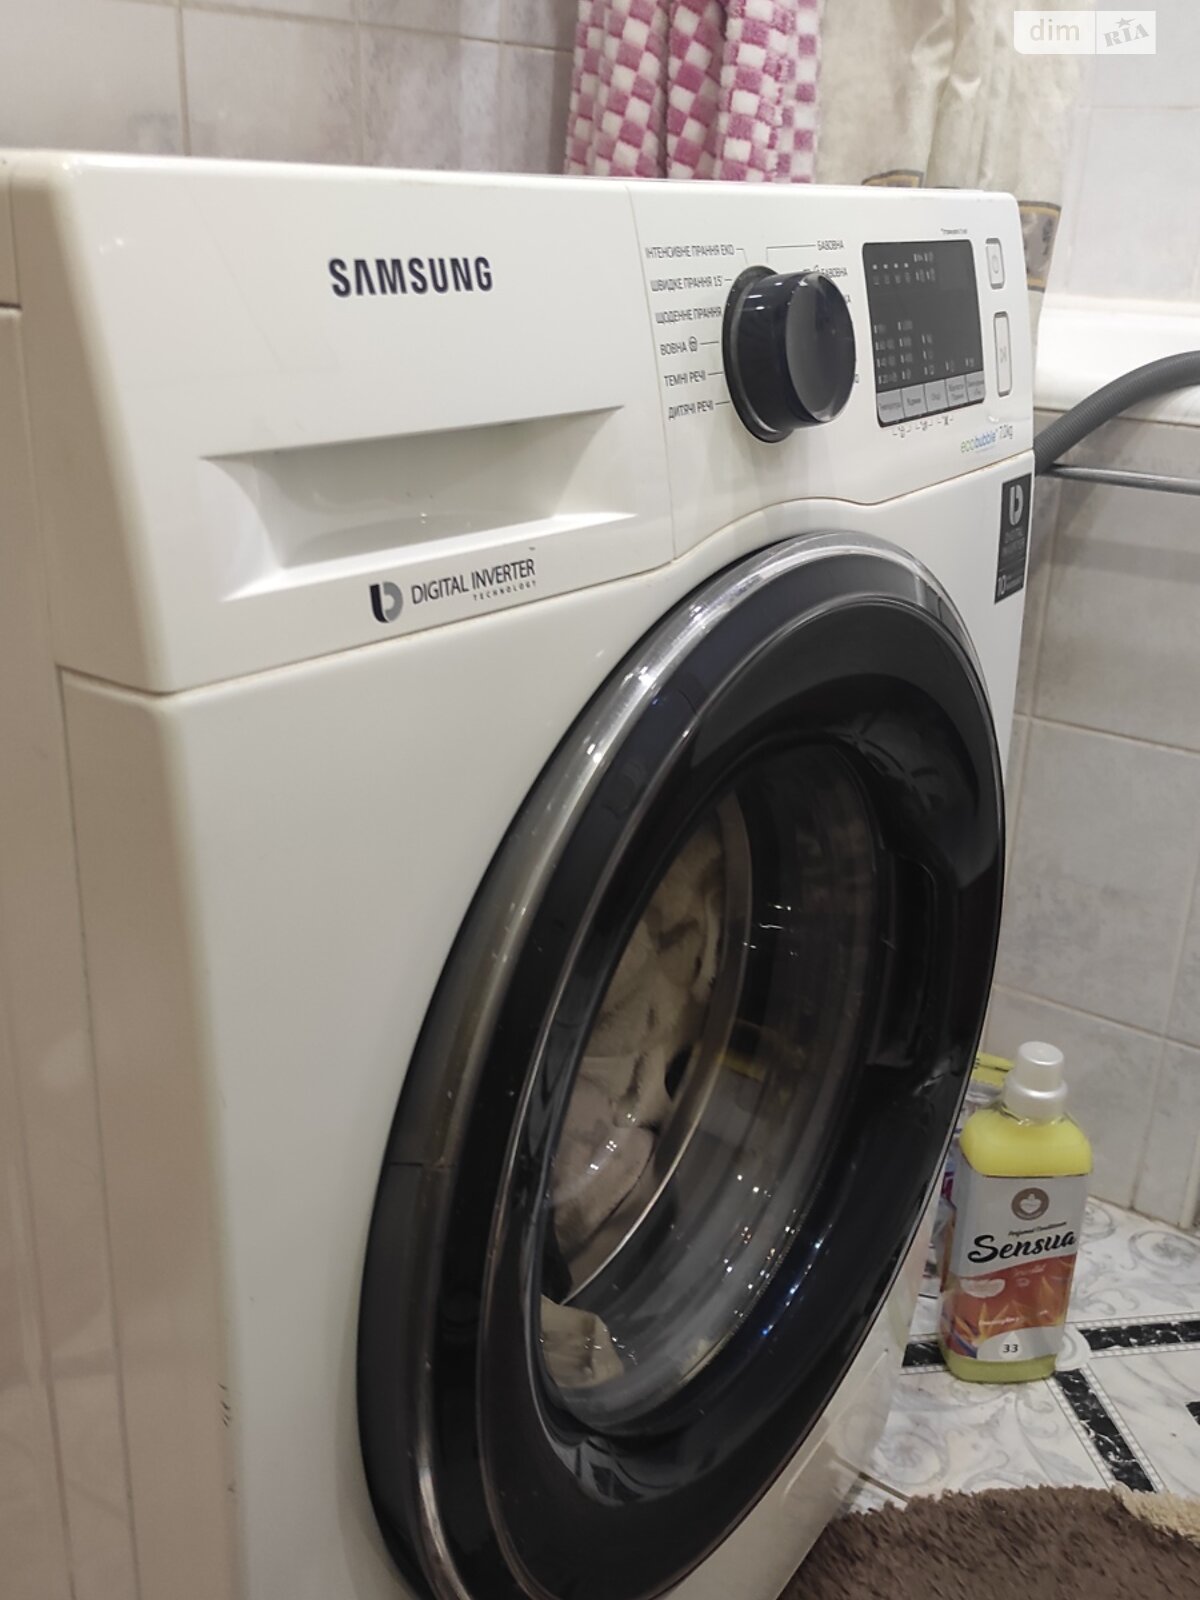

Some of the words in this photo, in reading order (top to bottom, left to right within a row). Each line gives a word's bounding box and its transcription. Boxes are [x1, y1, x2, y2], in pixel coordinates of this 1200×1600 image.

[692, 245, 719, 257] ПРАННЯ
[817, 240, 844, 250] БАВОВНА
[328, 256, 493, 298] SAMSUNG
[650, 278, 683, 292] ШВИДКЕ
[684, 276, 712, 288] ПРАННЯ
[655, 309, 693, 324] ЩОДЕННЕ
[660, 342, 687, 356] ВОВНА
[664, 373, 688, 387] ТЕМНІ
[689, 370, 706, 383] РЕЧІ
[668, 403, 696, 419] ДИТЯЧІ
[697, 400, 714, 414] РЕЧІ
[411, 574, 469, 605] DIGITAL
[471, 558, 536, 590] INVERTER
[473, 580, 537, 601] TECHNOLOGY
[967, 1231, 1076, 1263] Sensua
[1002, 1344, 1018, 1353] 33
